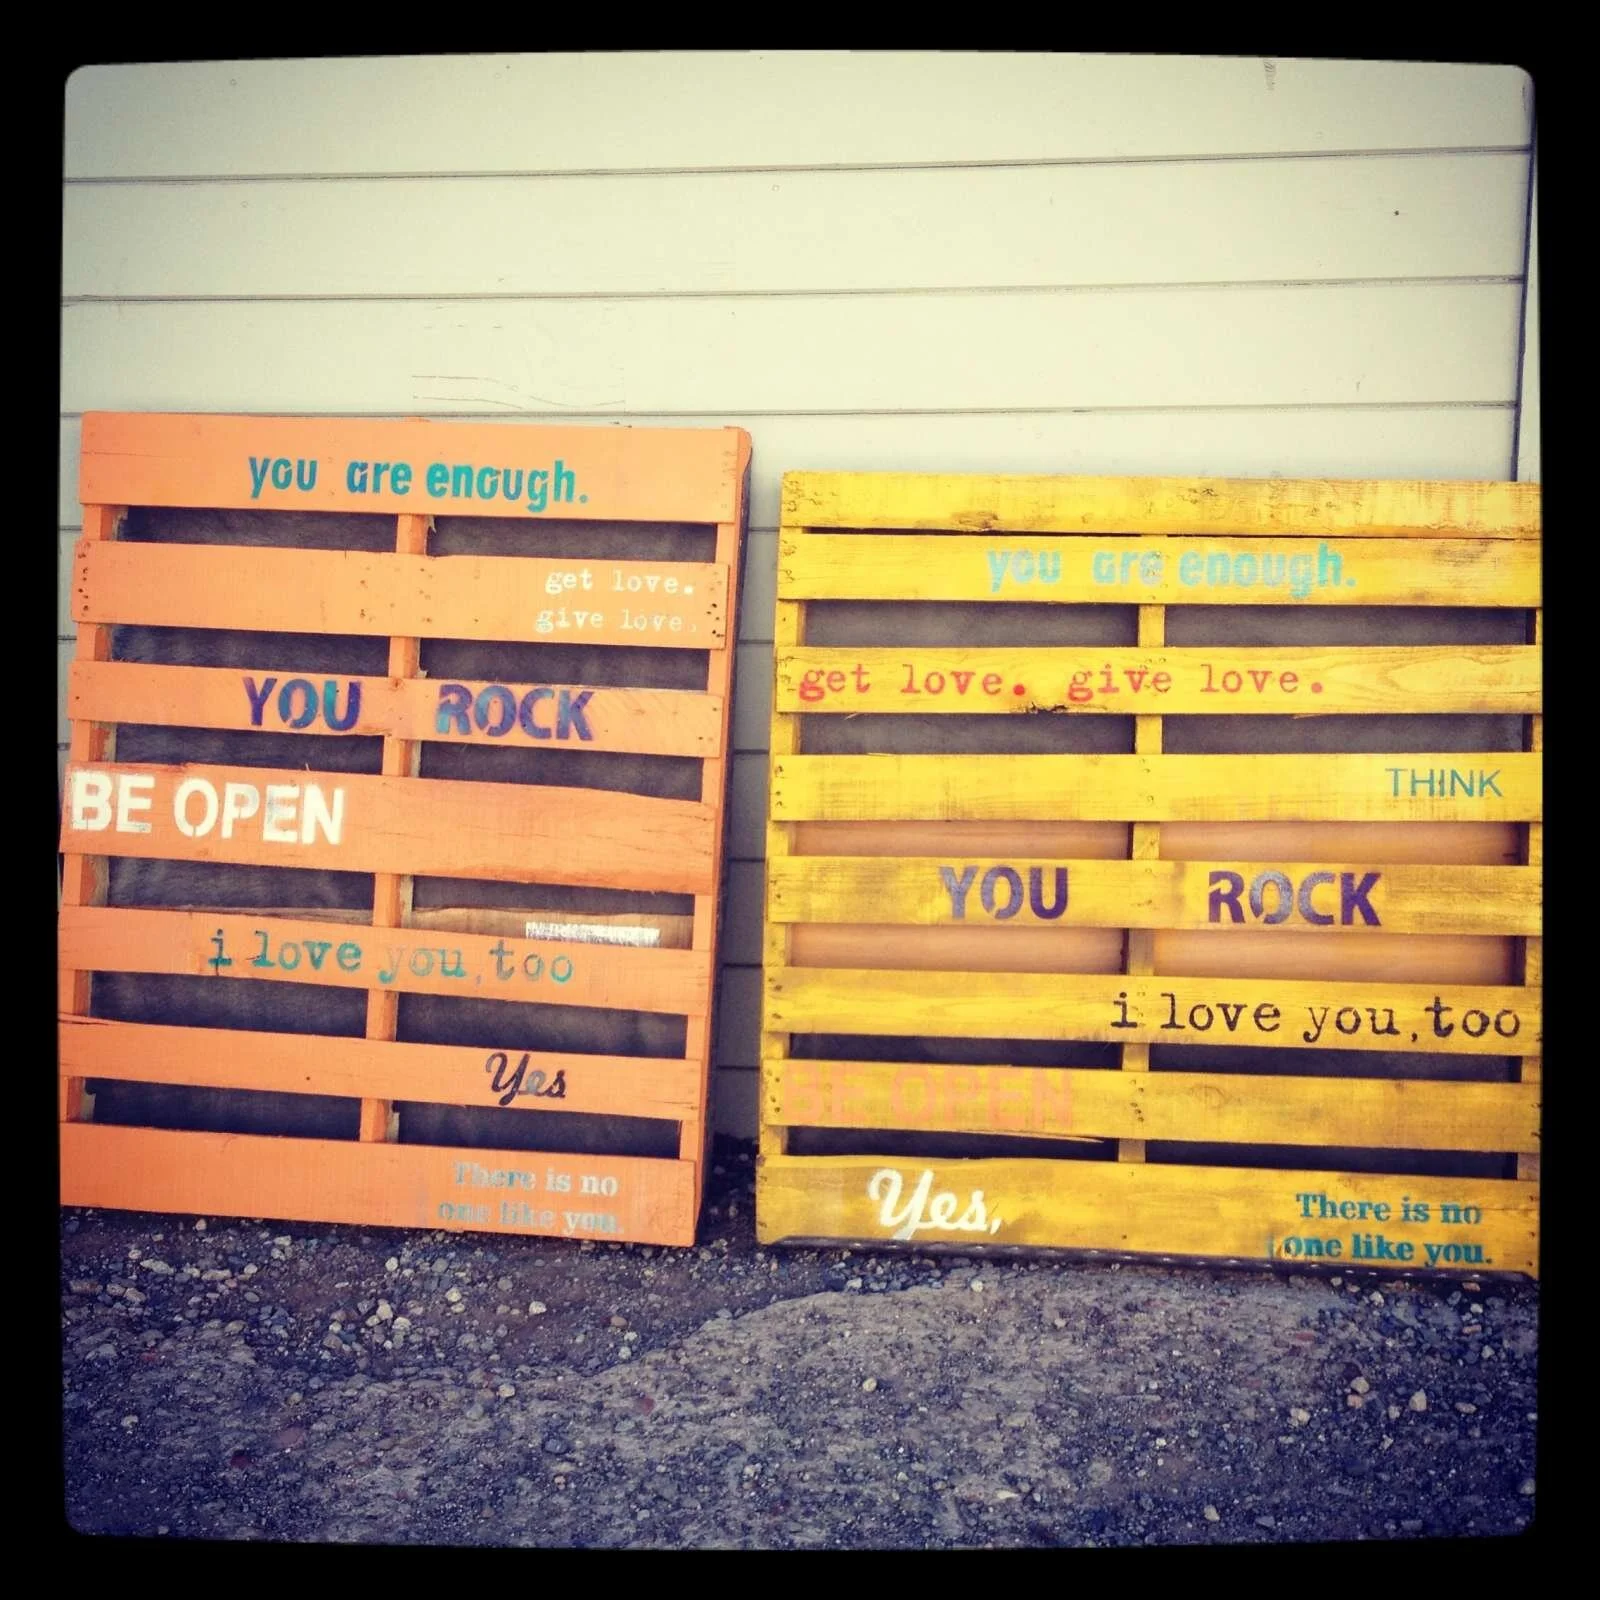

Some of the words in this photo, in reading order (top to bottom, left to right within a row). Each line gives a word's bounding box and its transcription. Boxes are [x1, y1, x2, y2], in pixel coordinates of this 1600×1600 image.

[249, 456, 318, 499] you
[346, 460, 413, 495] are
[426, 459, 589, 513] enough.
[544, 567, 594, 595] get
[612, 569, 695, 594] love.
[986, 547, 1062, 593] you
[1092, 549, 1164, 586] are
[1178, 543, 1356, 599] enough.
[534, 607, 604, 634] give
[799, 664, 871, 702] get
[900, 664, 1026, 697] love.
[1067, 664, 1172, 702] give
[1200, 664, 1324, 694] love.
[243, 675, 363, 732] YOU
[435, 683, 595, 742] ROCK
[1384, 767, 1504, 799] THINK
[71, 768, 156, 834] BE
[173, 776, 346, 846] OPEN
[939, 864, 1069, 921] YOU
[1207, 870, 1382, 927] ROCK
[207, 928, 233, 976] i
[250, 929, 363, 971] love
[1110, 991, 1138, 1029] i
[1160, 992, 1281, 1032] love
[485, 1051, 567, 1106] Yes
[782, 1061, 865, 1124] BE
[890, 1065, 1073, 1128] OPEN
[454, 1160, 536, 1190] There
[545, 1167, 571, 1193] is
[580, 1173, 619, 1198] no
[438, 1200, 490, 1224] one
[501, 1201, 555, 1229] like
[561, 1209, 624, 1236] you.
[866, 1168, 1002, 1241] Yes,
[1296, 1192, 1391, 1222] There
[1401, 1196, 1430, 1223] is
[1440, 1203, 1482, 1224] no
[1284, 1236, 1343, 1257] one
[1352, 1233, 1415, 1261] like
[1424, 1242, 1493, 1268] you.
